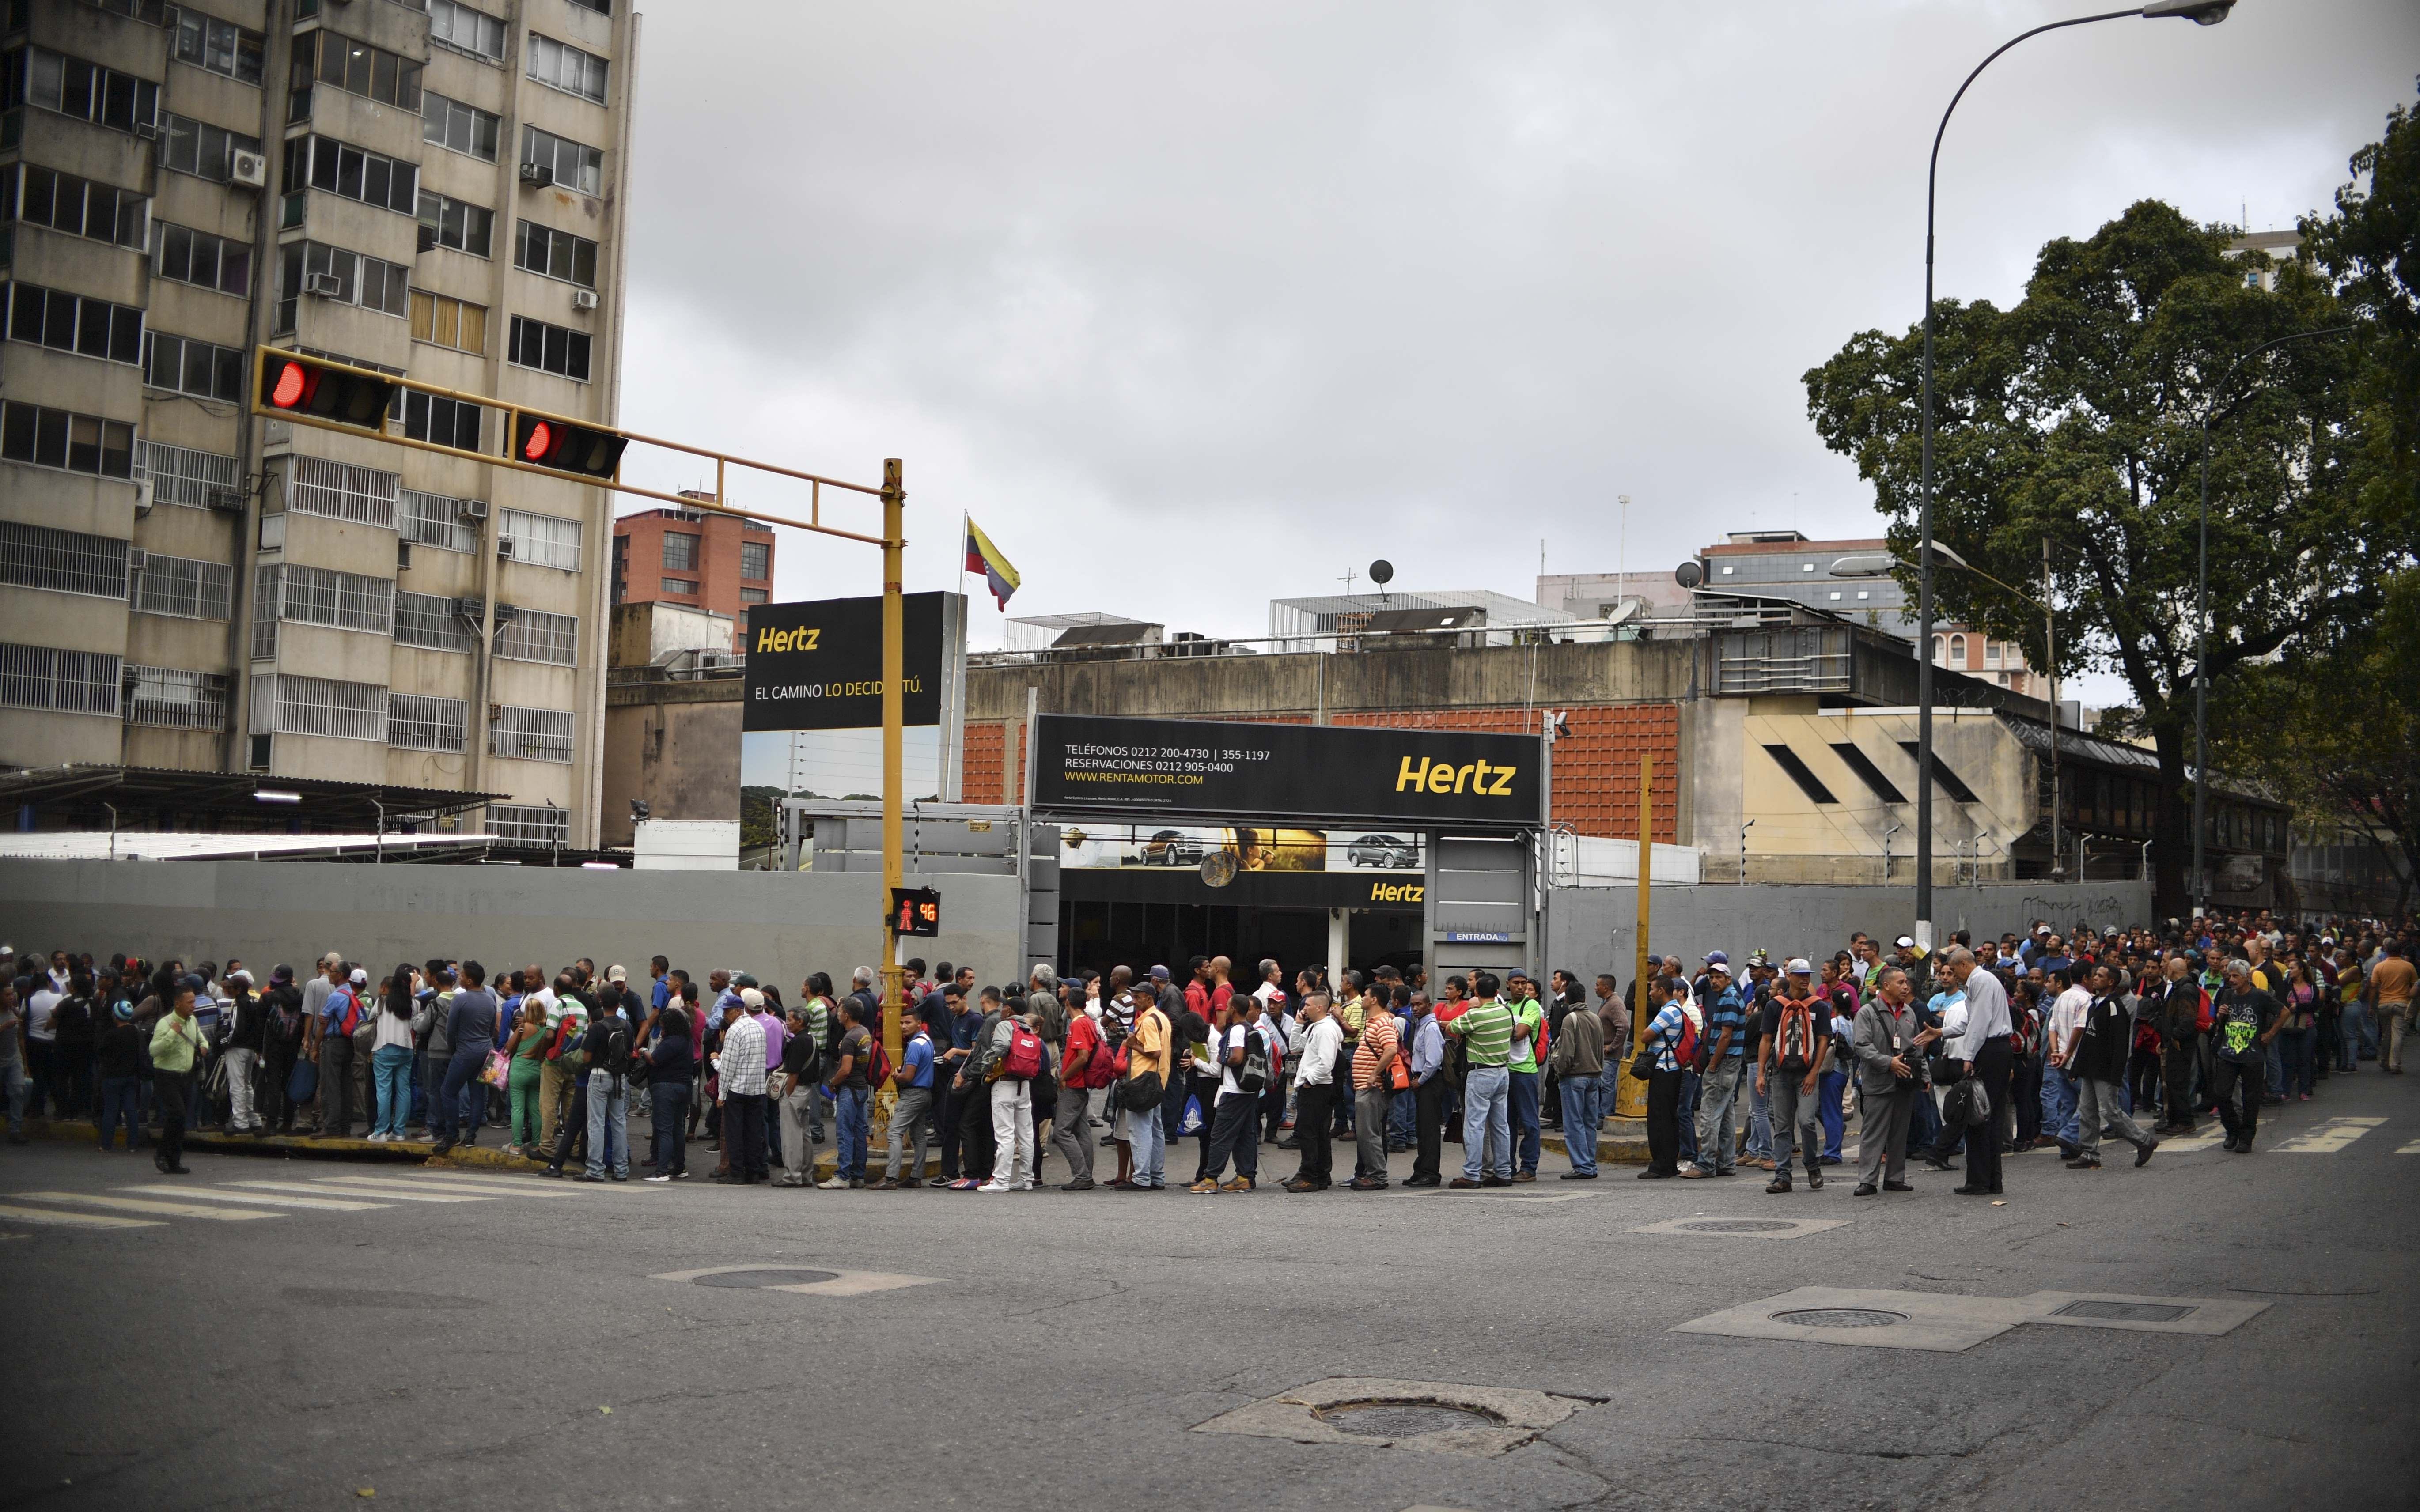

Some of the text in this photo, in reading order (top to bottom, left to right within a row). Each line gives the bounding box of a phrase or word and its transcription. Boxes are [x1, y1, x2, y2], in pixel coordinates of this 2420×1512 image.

[757, 626, 820, 653] Hertz
[755, 687, 769, 700] EL
[772, 684, 822, 699] CAMINO
[826, 682, 842, 697] LO
[845, 680, 883, 696] DECID
[1065, 743, 1128, 756] TELÉFONOS
[1131, 747, 1157, 757] 0212
[1161, 748, 1209, 759] 200-4730
[1222, 750, 1270, 760] 355-1197
[1065, 758, 1233, 772] RESERVACIONES 0212 905-0400
[1065, 772, 1203, 785] WWW.RENTAMOTOR.COM
[1396, 756, 1516, 796] Hertz
[1371, 883, 1424, 902] Hertz
[920, 903, 937, 922] 46
